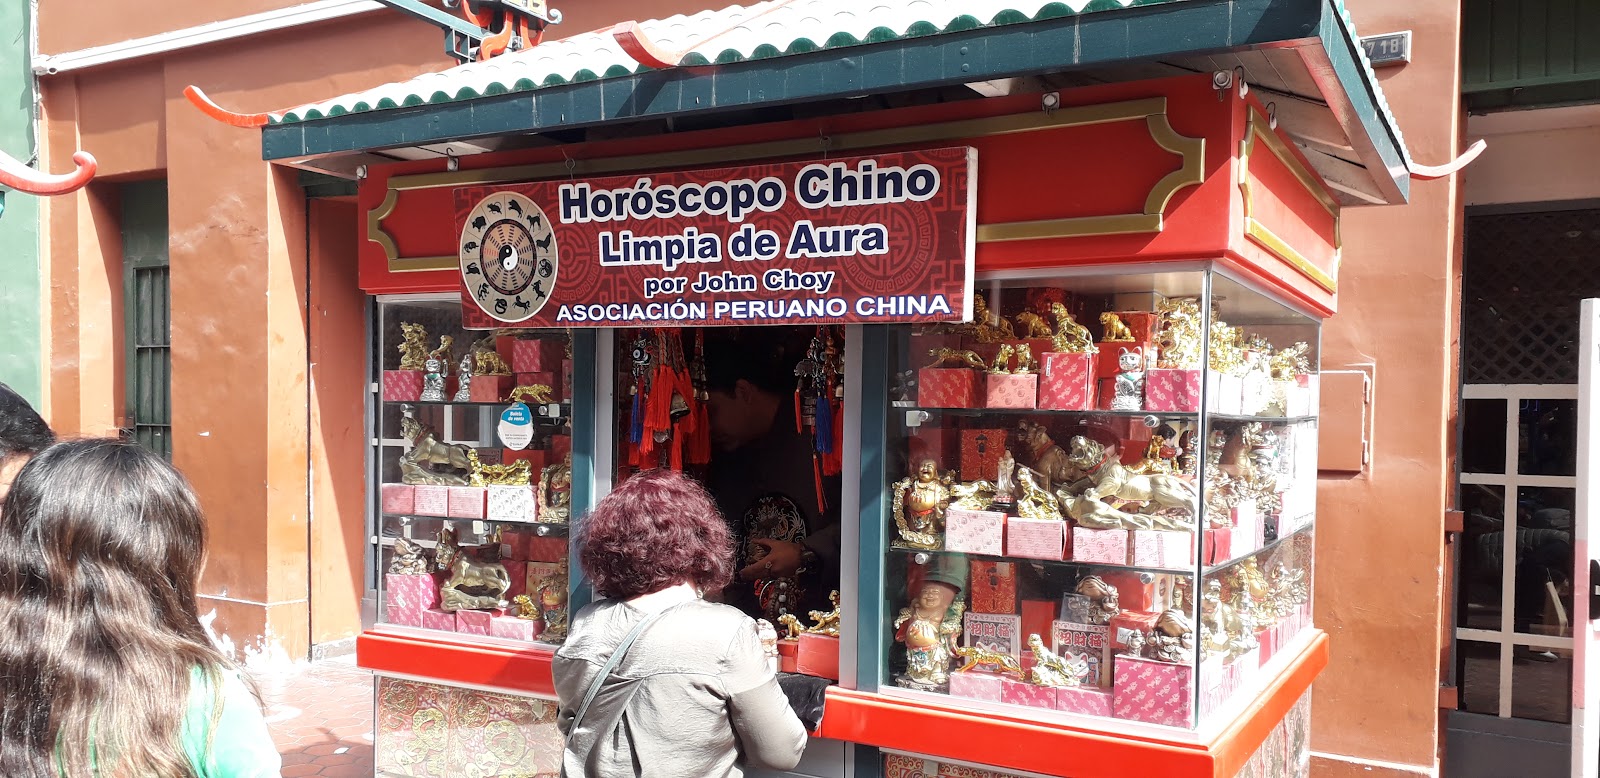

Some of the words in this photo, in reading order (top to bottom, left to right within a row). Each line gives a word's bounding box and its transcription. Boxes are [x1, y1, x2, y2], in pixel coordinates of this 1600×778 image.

[1367, 39, 1398, 56] 718
[561, 179, 784, 221] Horóscopo
[798, 163, 937, 205] Chino
[600, 229, 719, 268] Limpia
[730, 226, 778, 258] de
[788, 222, 886, 257] Aura
[645, 276, 687, 297] por
[691, 271, 756, 294] John
[763, 269, 835, 294] Choy
[556, 298, 703, 321] ASOCIACIÓN
[713, 297, 848, 319] PERUANO
[855, 294, 951, 317] CHINA
